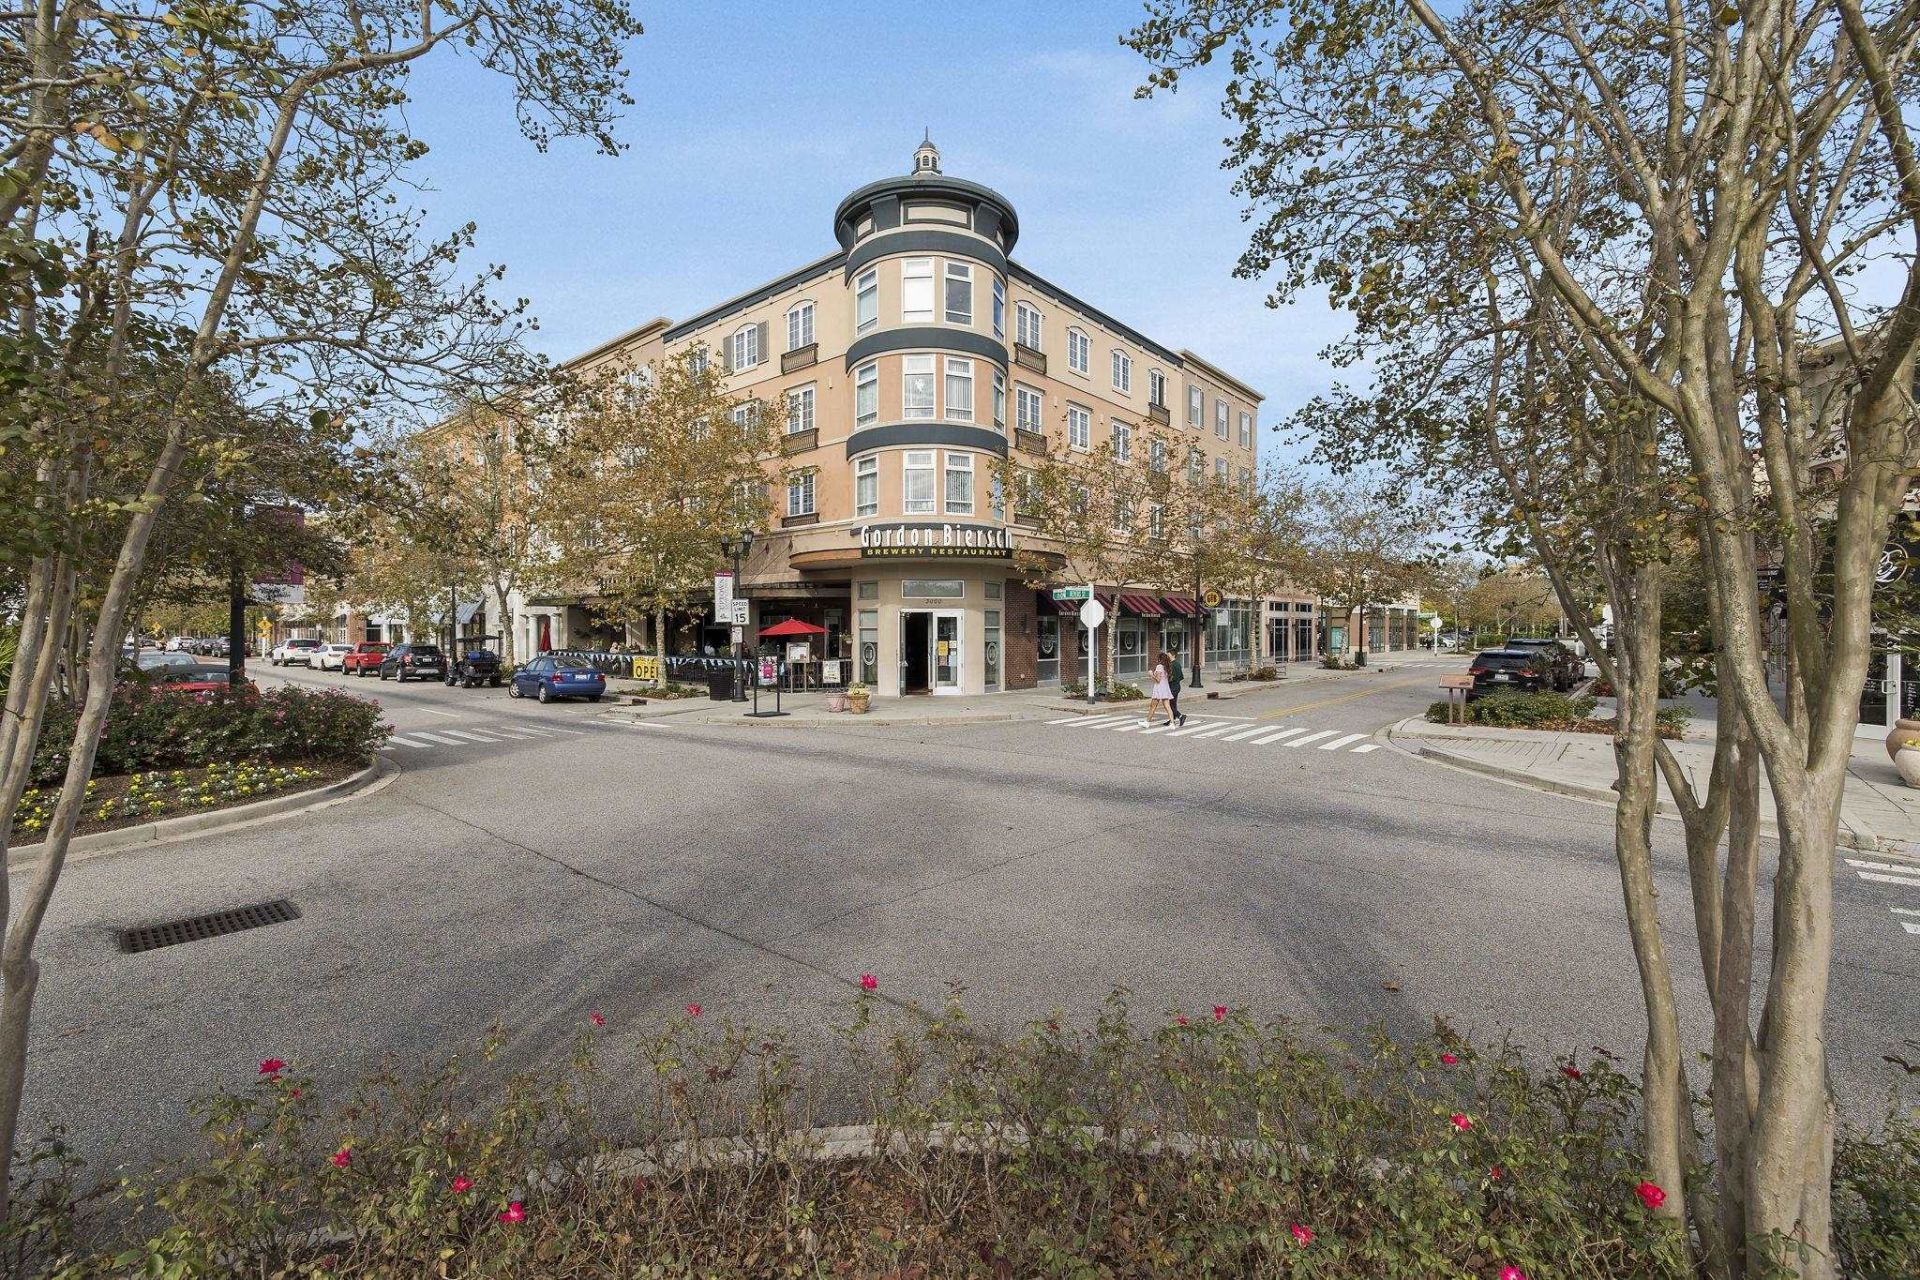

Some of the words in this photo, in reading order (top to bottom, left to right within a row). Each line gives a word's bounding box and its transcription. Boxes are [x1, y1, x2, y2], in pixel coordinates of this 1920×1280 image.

[861, 525, 933, 547] Gordon
[943, 524, 1012, 548] Biersch
[931, 548, 1007, 556] RESTAURANT
[735, 613, 746, 623] 15
[635, 665, 658, 678] OPE
